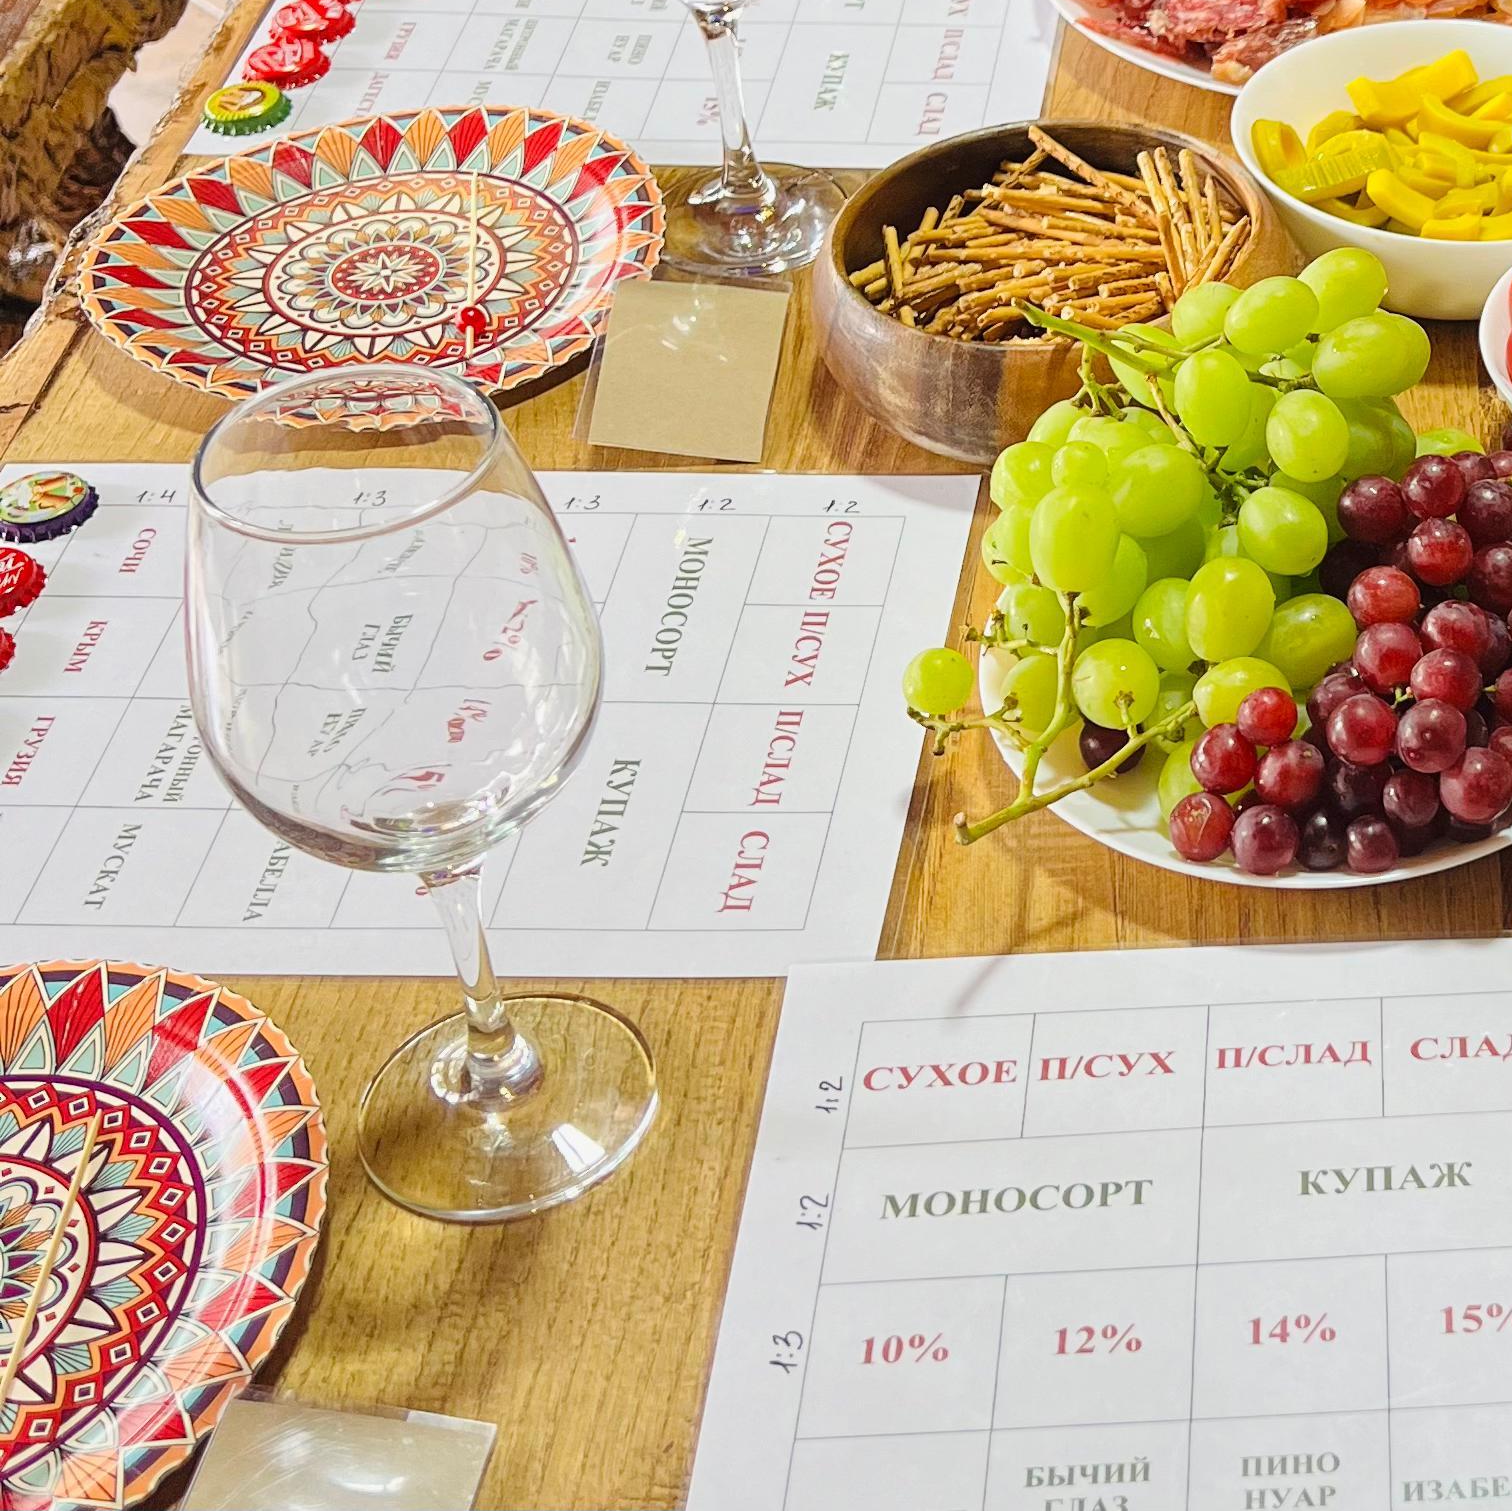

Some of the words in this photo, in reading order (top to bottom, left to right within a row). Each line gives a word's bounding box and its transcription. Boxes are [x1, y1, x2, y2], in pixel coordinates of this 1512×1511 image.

[814, 51, 850, 111] КУПАЖ
[136, 489, 176, 504] 1:4
[352, 490, 387, 507] 1:3
[563, 494, 602, 511] 1:3
[697, 497, 737, 511] 1:2
[823, 499, 861, 514] 1:2
[118, 527, 157, 574] СОЧИ
[808, 520, 854, 601] СУХОЕ
[643, 536, 715, 677] МОНОСОРТ
[63, 620, 109, 673] КРЫМ
[372, 613, 413, 674] БЫЧИЙ
[784, 609, 831, 688] П/СУХ
[1, 716, 56, 788] ГРУЗИЯ
[134, 704, 192, 803] МАГАРАЧА
[748, 709, 804, 806] П/СЛАД
[579, 757, 642, 868] КУПАЖ
[83, 823, 143, 911] МУСКАТ
[242, 840, 292, 923] АБЕЛЛА
[715, 830, 771, 913] СЛАД
[863, 1059, 1018, 1091] СУХОЕ
[1038, 1051, 1176, 1081] П/СУХ
[1216, 1040, 1372, 1069] П/СЛАД
[879, 1179, 1153, 1219] МОНОСОРТ
[1297, 1161, 1473, 1196] КУПАЖ
[860, 1332, 949, 1365] 10%
[1055, 1323, 1143, 1355] 12%
[1247, 1313, 1336, 1346] 14%
[1025, 1456, 1152, 1488] БЫЧИЙ
[1240, 1452, 1341, 1478] ПИНО
[1244, 1485, 1337, 1510] НУАР
